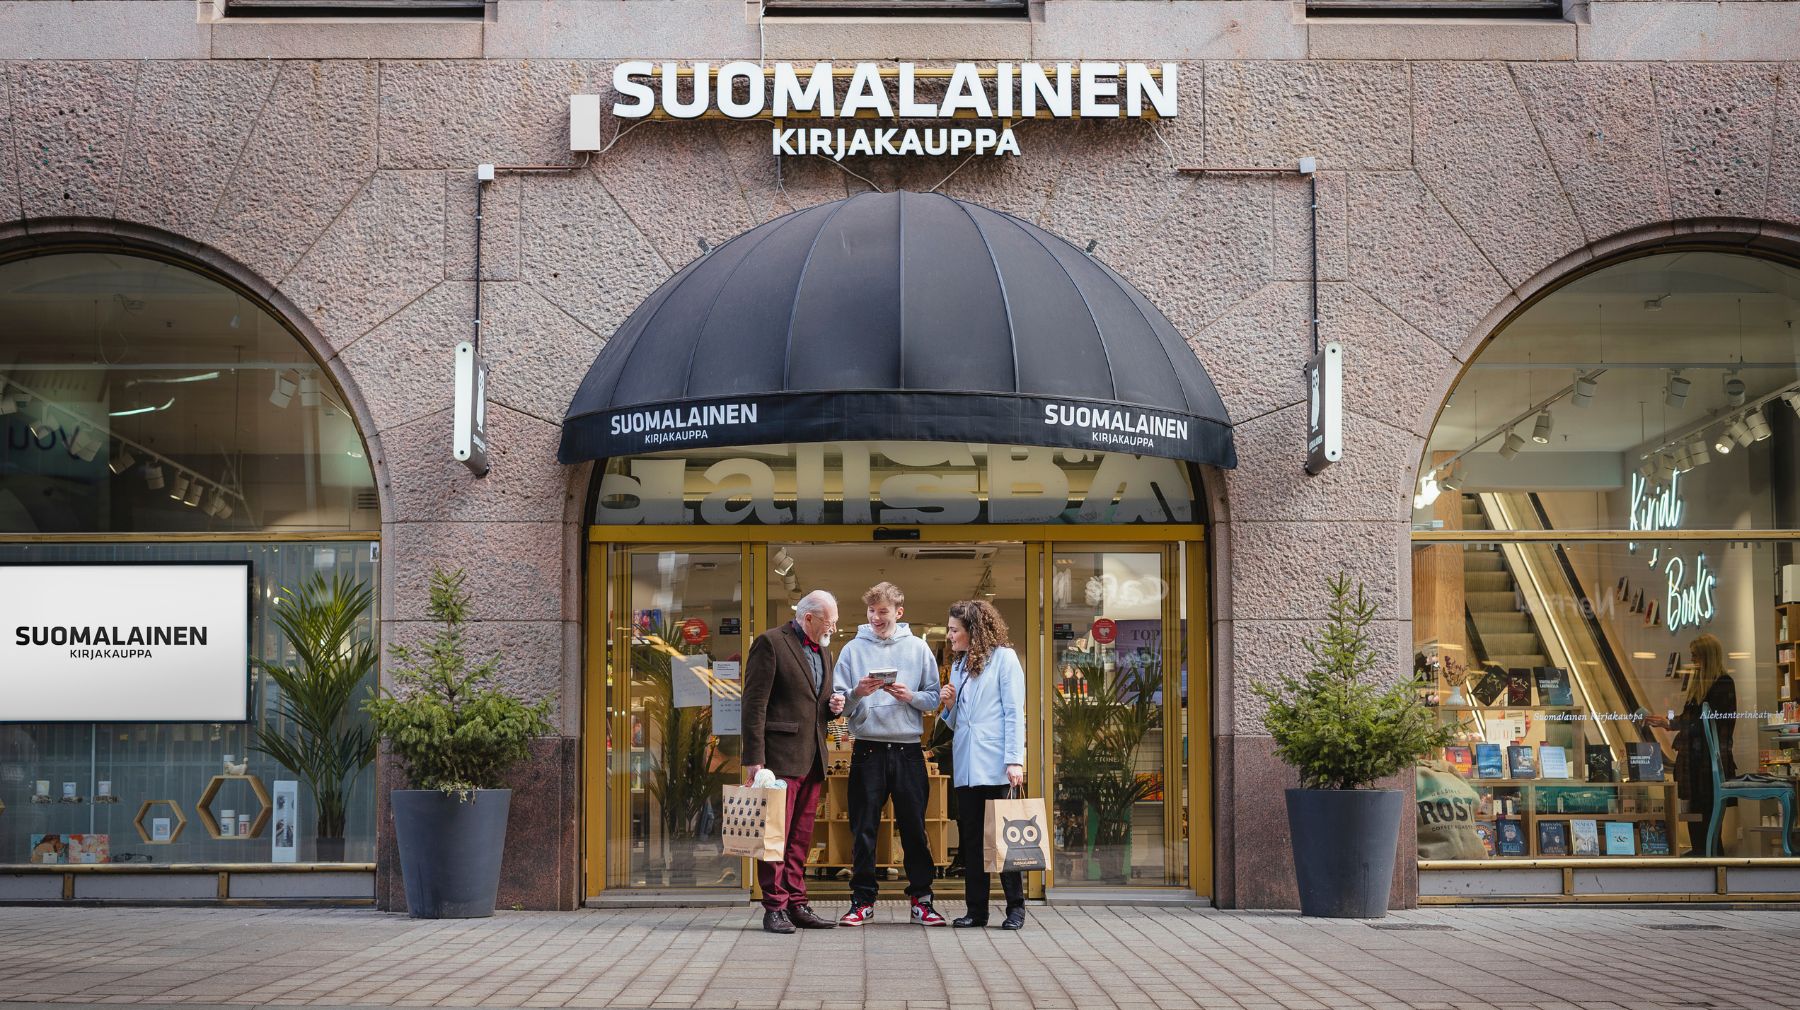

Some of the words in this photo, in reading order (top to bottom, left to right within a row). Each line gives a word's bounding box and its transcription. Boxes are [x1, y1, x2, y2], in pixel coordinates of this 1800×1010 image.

[612, 61, 1178, 119] SUOMALAINEN
[772, 127, 1022, 161] KIRJAKAUPPA
[610, 402, 758, 436] SUOMALAINEN
[1044, 403, 1188, 441] SUOMALAINEN
[644, 429, 709, 445] KIRJAKAUPPA
[1091, 431, 1155, 448] KIRJAKAUPPA
[1629, 466, 1682, 567] Kirjat
[1665, 555, 1713, 632] Books
[15, 625, 208, 647] SUOMALAINEN
[1130, 629, 1161, 641] TOP
[70, 648, 153, 660] KIRJAKAUPPA
[1533, 711, 1588, 721] Suomalainen
